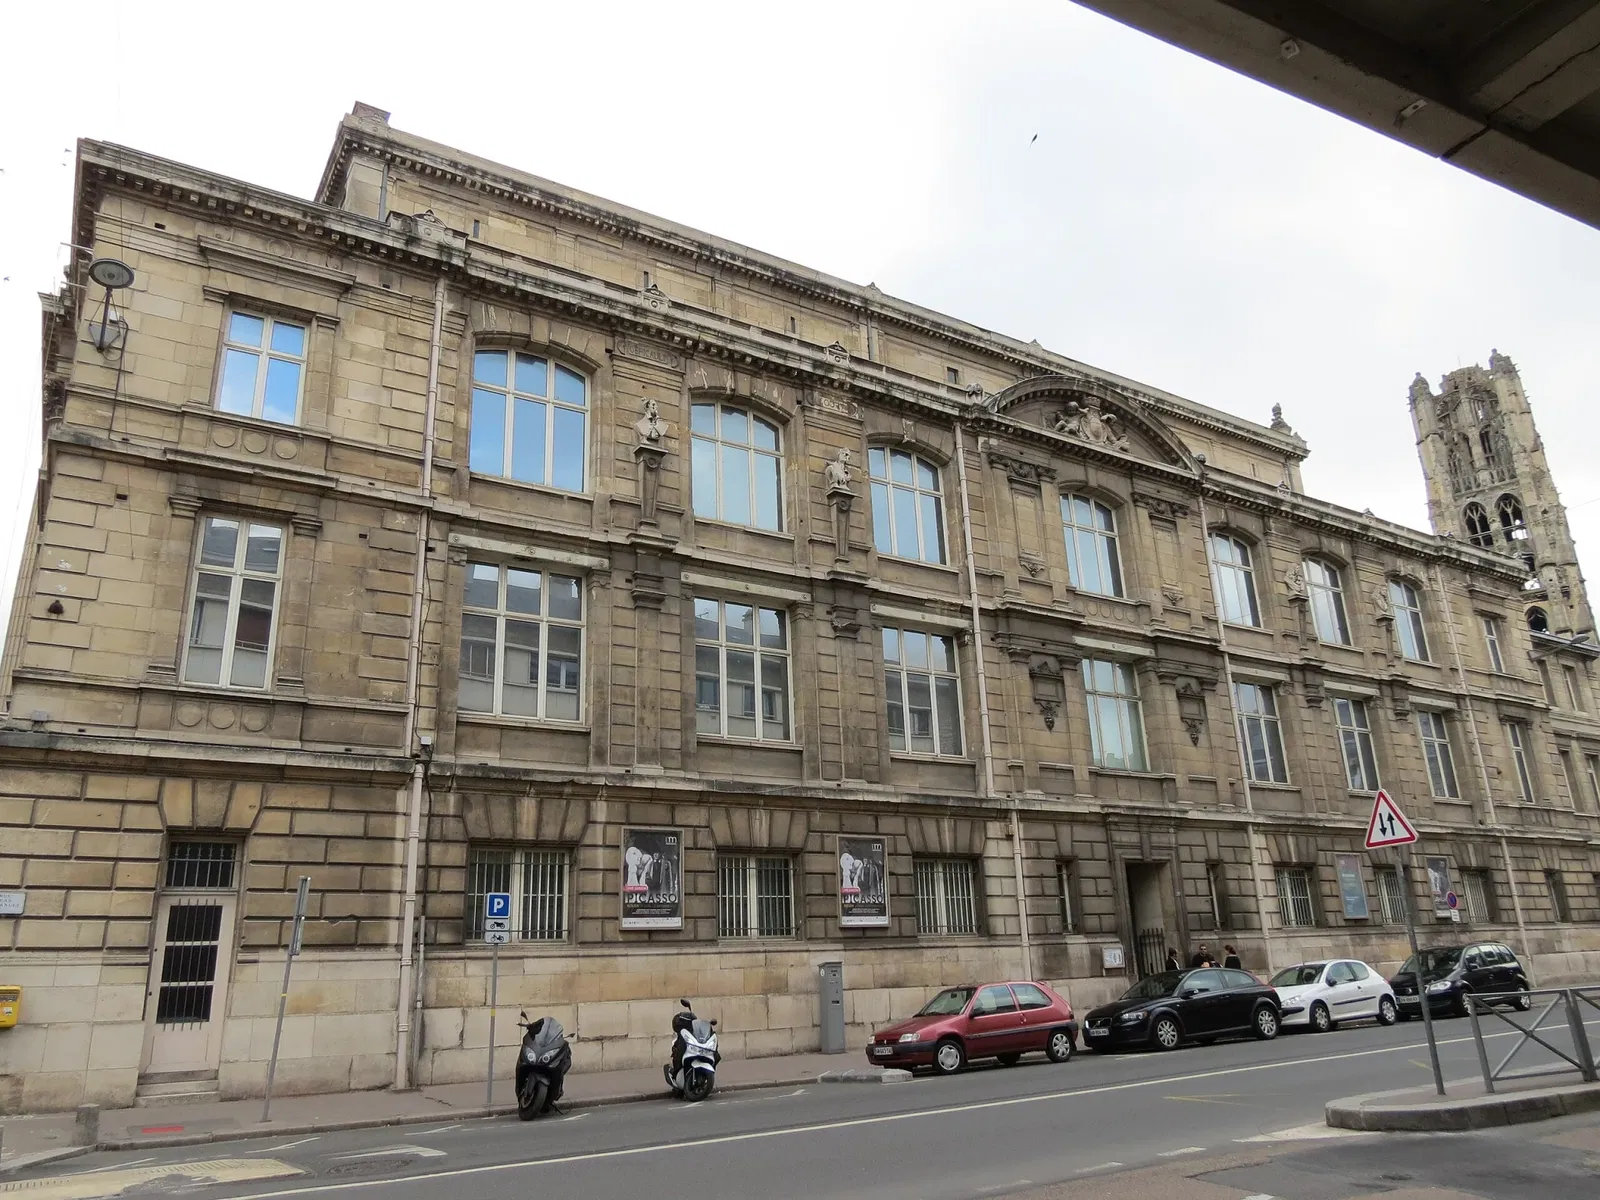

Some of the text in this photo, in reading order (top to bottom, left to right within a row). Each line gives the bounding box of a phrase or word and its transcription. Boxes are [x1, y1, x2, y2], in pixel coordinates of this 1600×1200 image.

[626, 893, 677, 904] PICASSO
[843, 894, 884, 904] PICASSO
[493, 898, 504, 913] P
